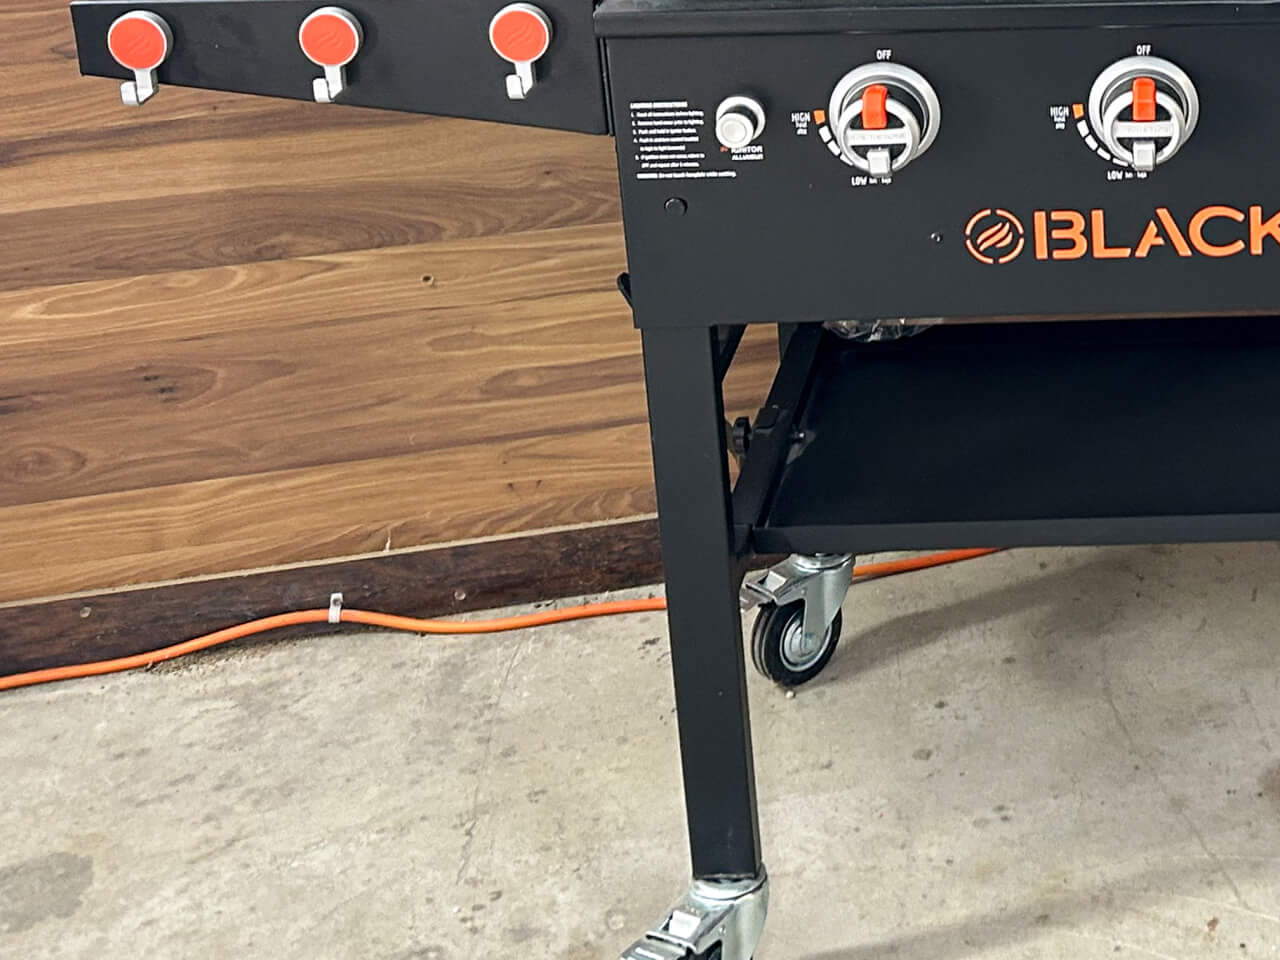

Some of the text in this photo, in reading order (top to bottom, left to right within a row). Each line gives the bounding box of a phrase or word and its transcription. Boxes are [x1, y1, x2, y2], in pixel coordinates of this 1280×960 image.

[876, 49, 892, 60] OFF
[1136, 45, 1151, 55] OFF
[1107, 171, 1123, 180] LOW
[851, 176, 867, 186] LOW
